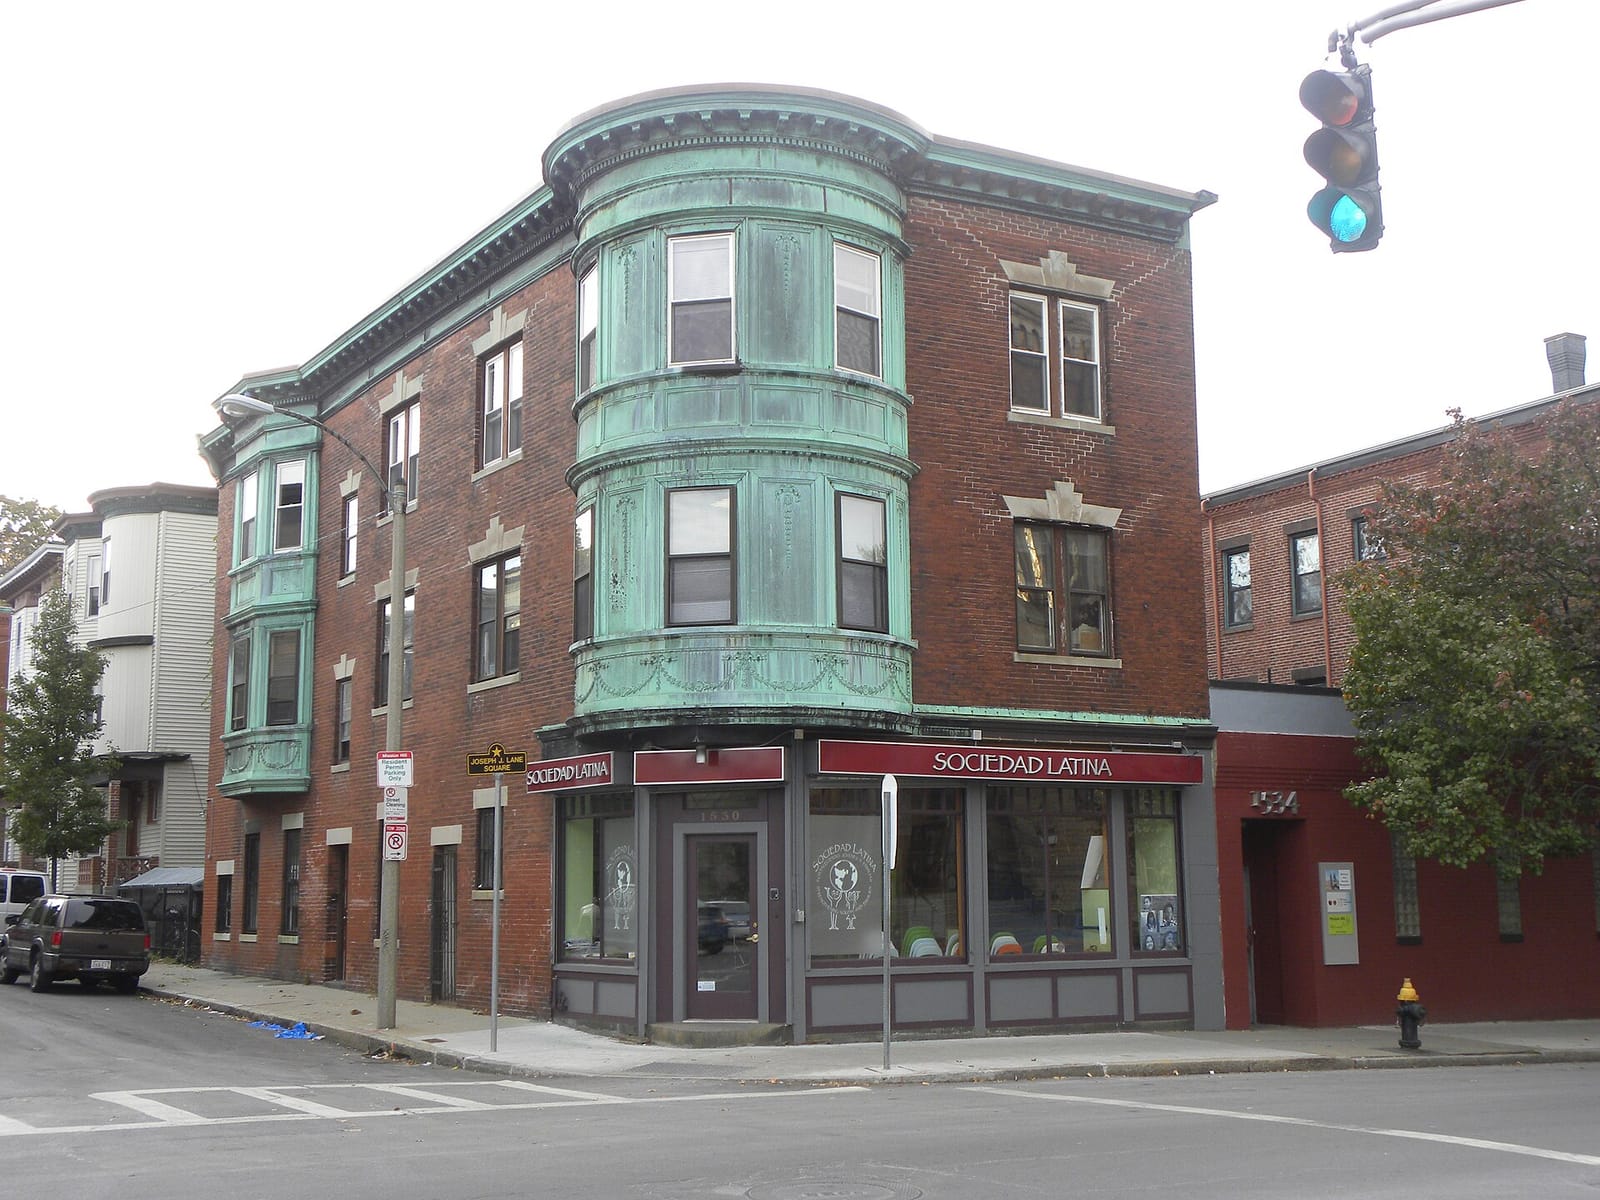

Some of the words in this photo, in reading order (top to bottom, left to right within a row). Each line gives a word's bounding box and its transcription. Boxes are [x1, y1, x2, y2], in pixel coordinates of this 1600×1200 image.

[484, 764, 511, 772] SQUARE
[526, 765, 574, 785] SOCIEDAD
[575, 761, 608, 779] LATINA
[932, 752, 1043, 774] SOCIEDAD
[1047, 757, 1112, 776] LATINA
[1249, 790, 1300, 815] 1534
[812, 843, 851, 872] SOCIEDAD
[852, 843, 877, 872] LATINA
